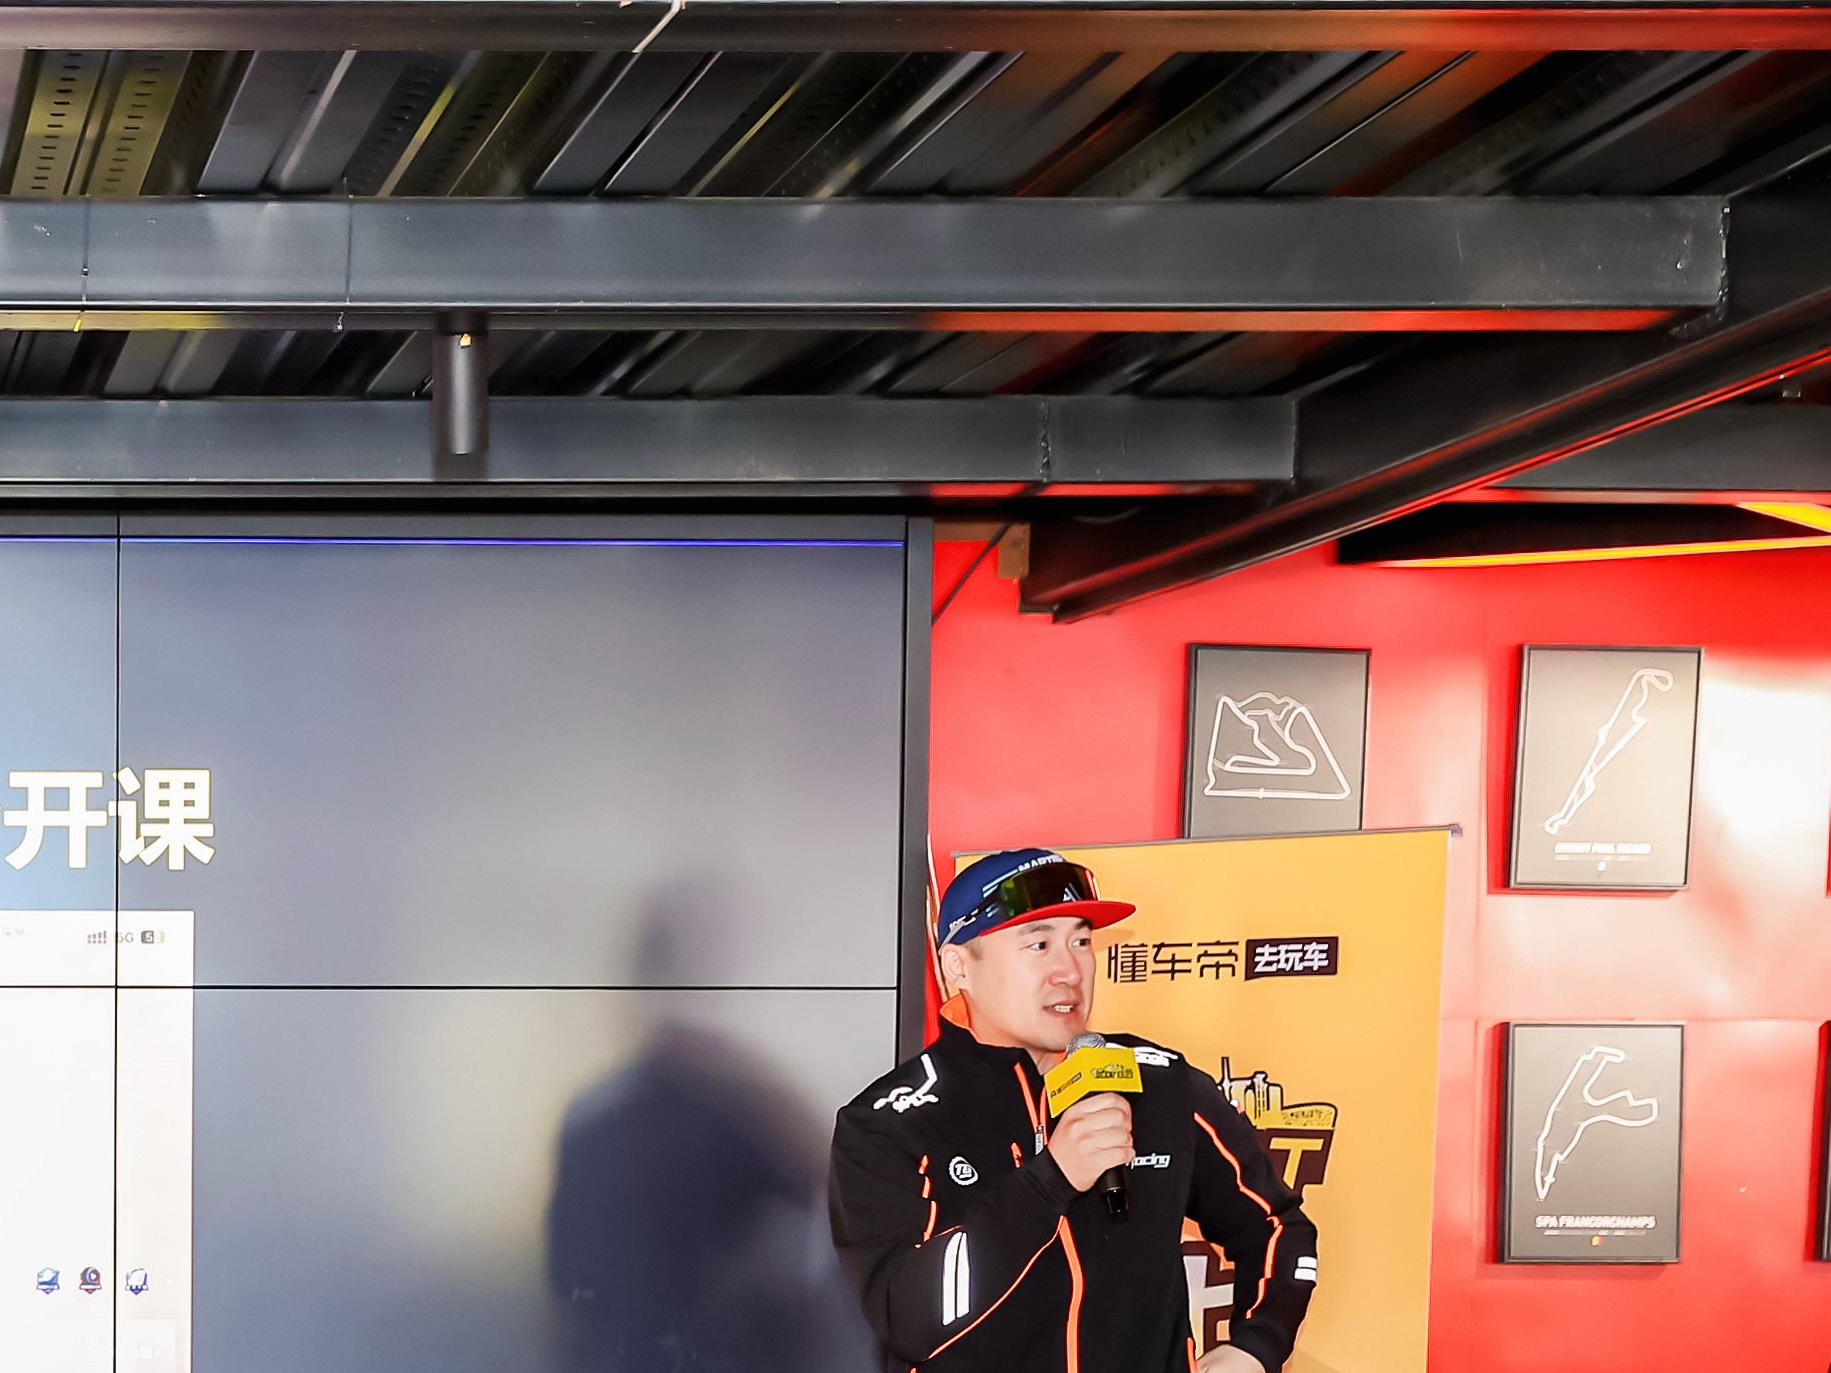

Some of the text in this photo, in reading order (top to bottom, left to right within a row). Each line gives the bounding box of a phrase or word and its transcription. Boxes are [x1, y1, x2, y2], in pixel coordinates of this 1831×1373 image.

[1106, 940, 1330, 984] 懂车帝 去玩车
